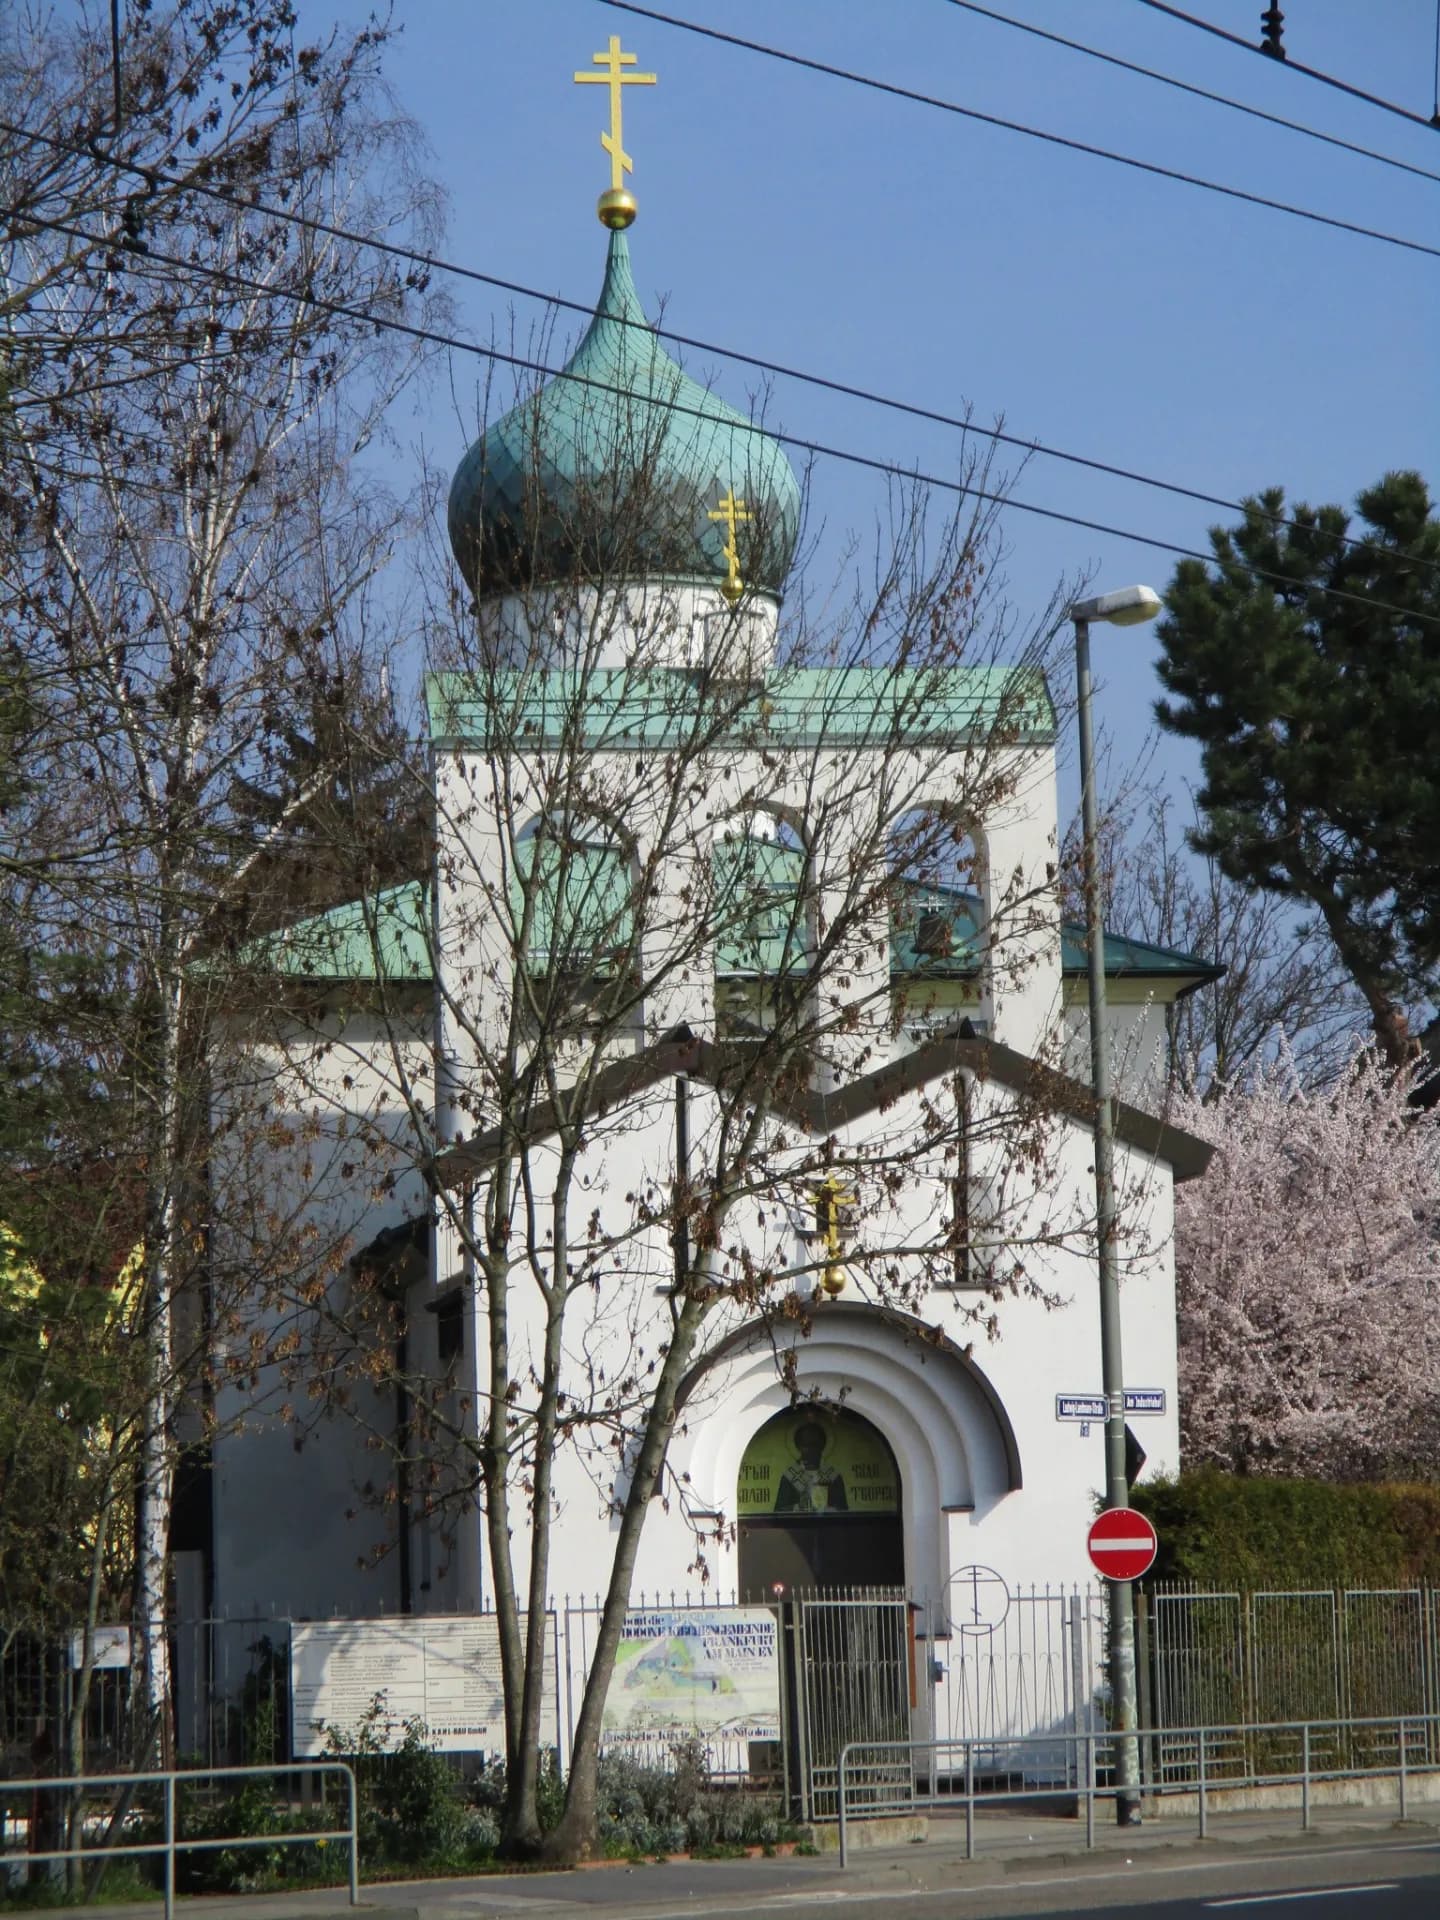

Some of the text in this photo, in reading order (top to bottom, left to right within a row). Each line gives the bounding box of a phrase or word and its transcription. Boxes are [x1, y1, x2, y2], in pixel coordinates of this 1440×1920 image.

[1127, 1395, 1134, 1408] Am
[703, 1635, 775, 1648] FRANKFURT
[725, 1648, 756, 1659] MAIN
